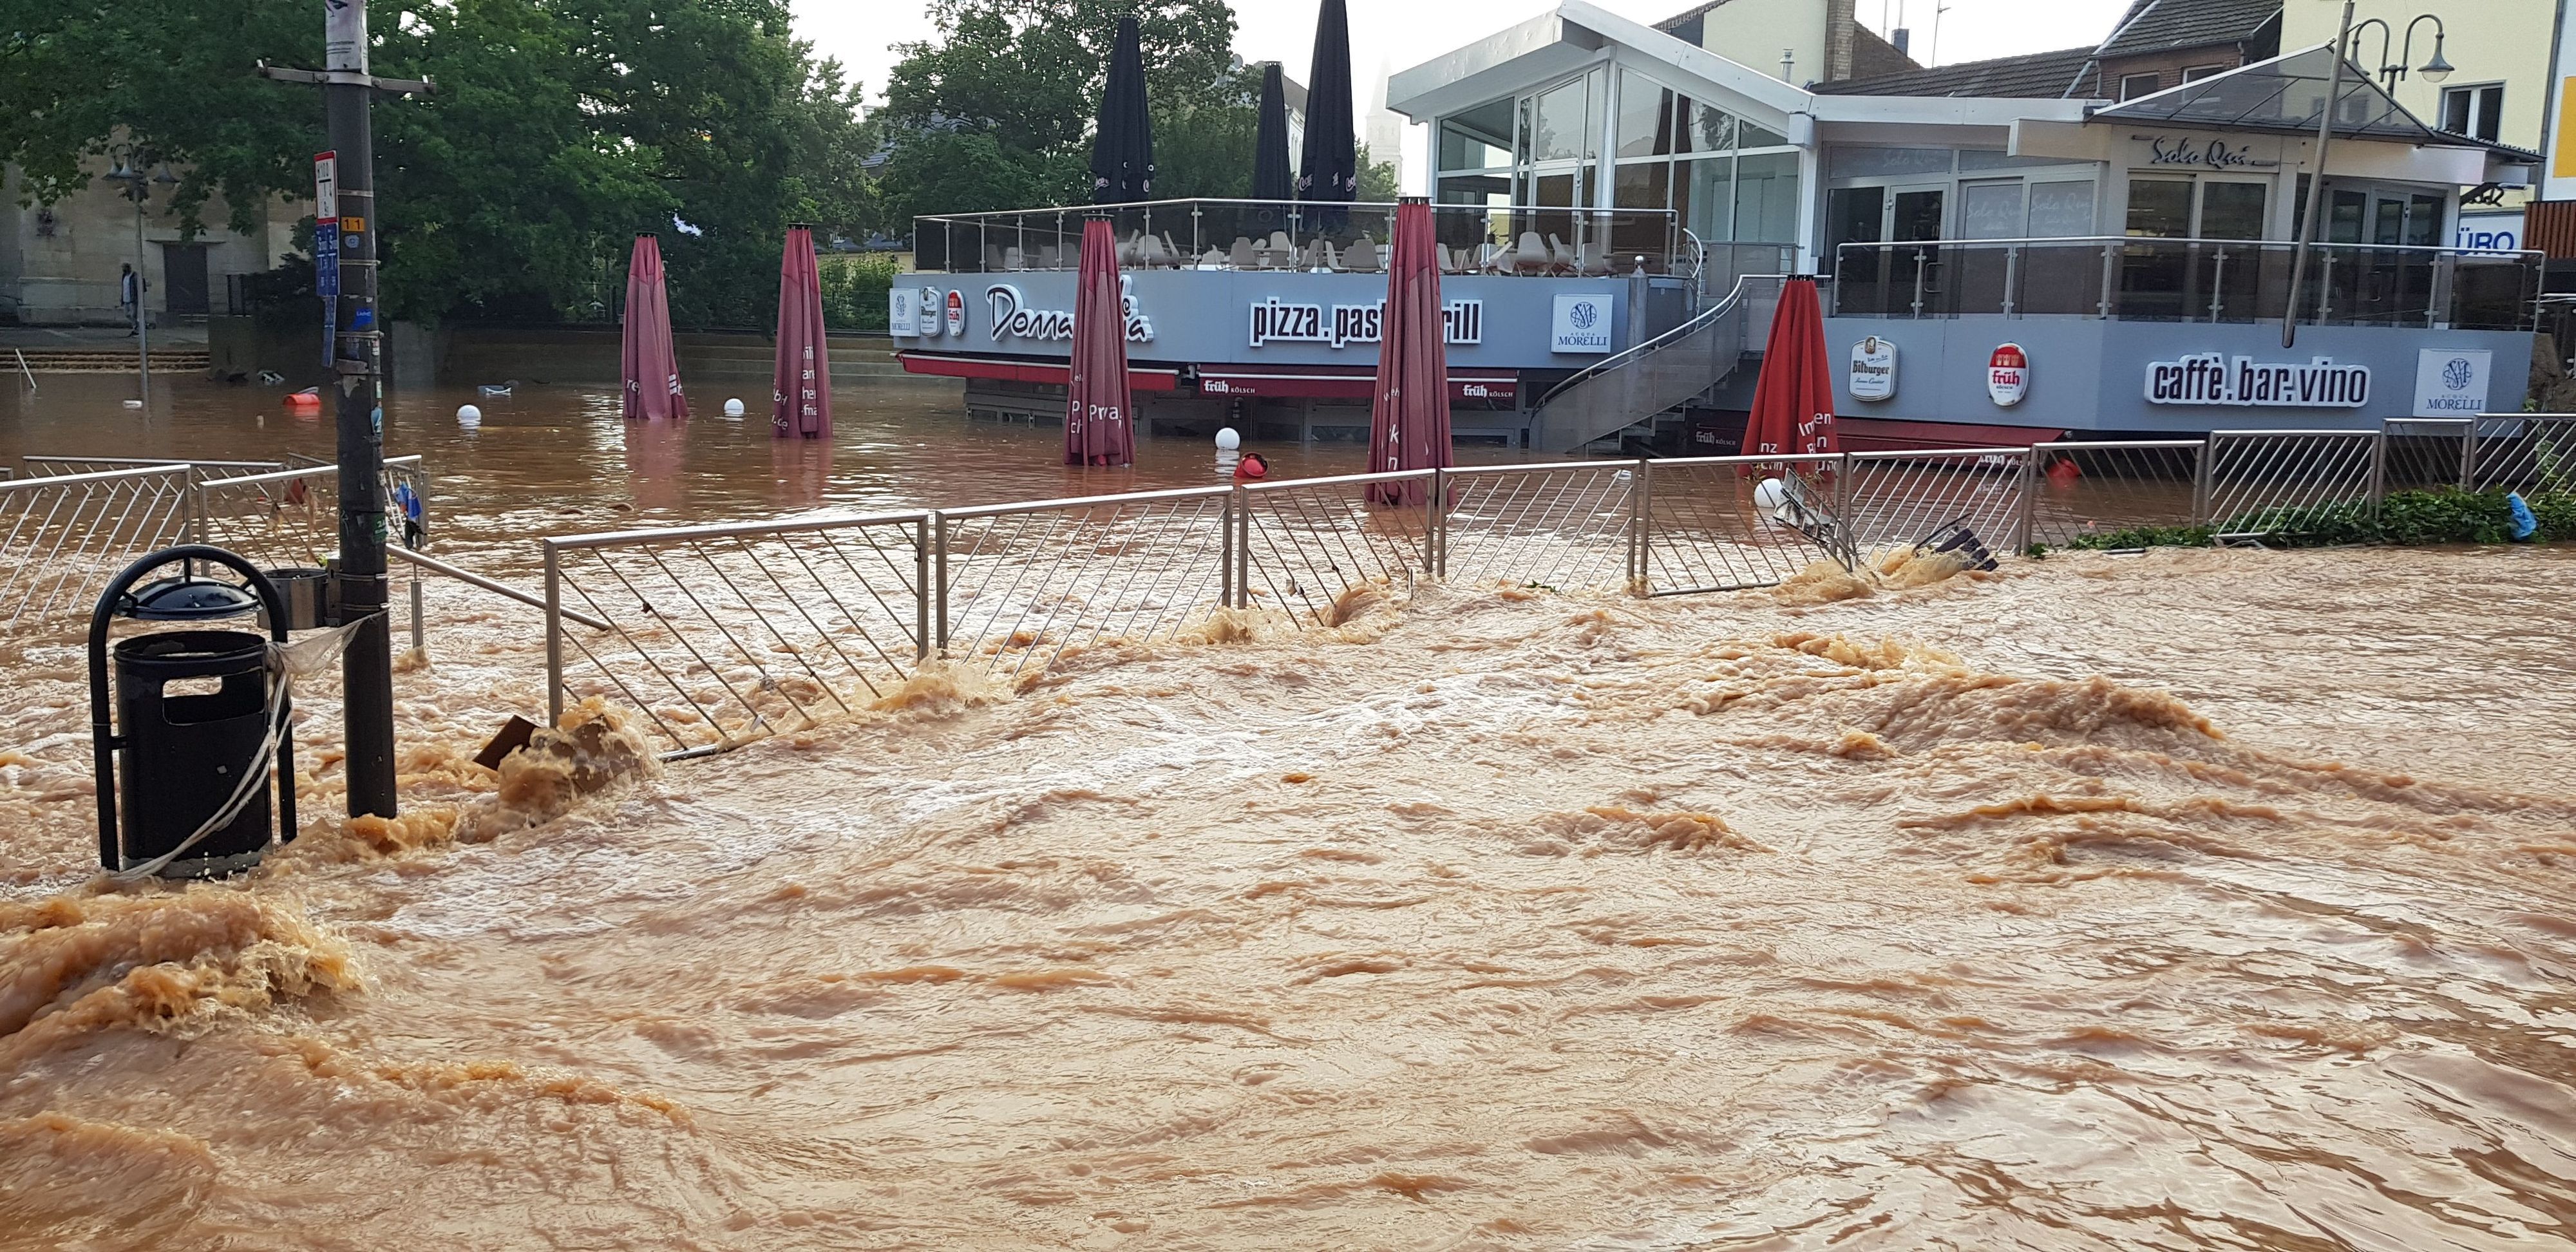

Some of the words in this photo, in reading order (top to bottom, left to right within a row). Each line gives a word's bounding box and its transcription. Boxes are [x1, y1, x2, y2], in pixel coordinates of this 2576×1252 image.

[987, 287, 1073, 337] Donna
[1558, 336, 1607, 346] MORELLI
[1853, 360, 1889, 377] Bitburger
[1993, 370, 2020, 387] früh
[1204, 379, 1229, 394] früh
[1463, 384, 1488, 398] früh
[2426, 399, 2482, 410] MORELLI
